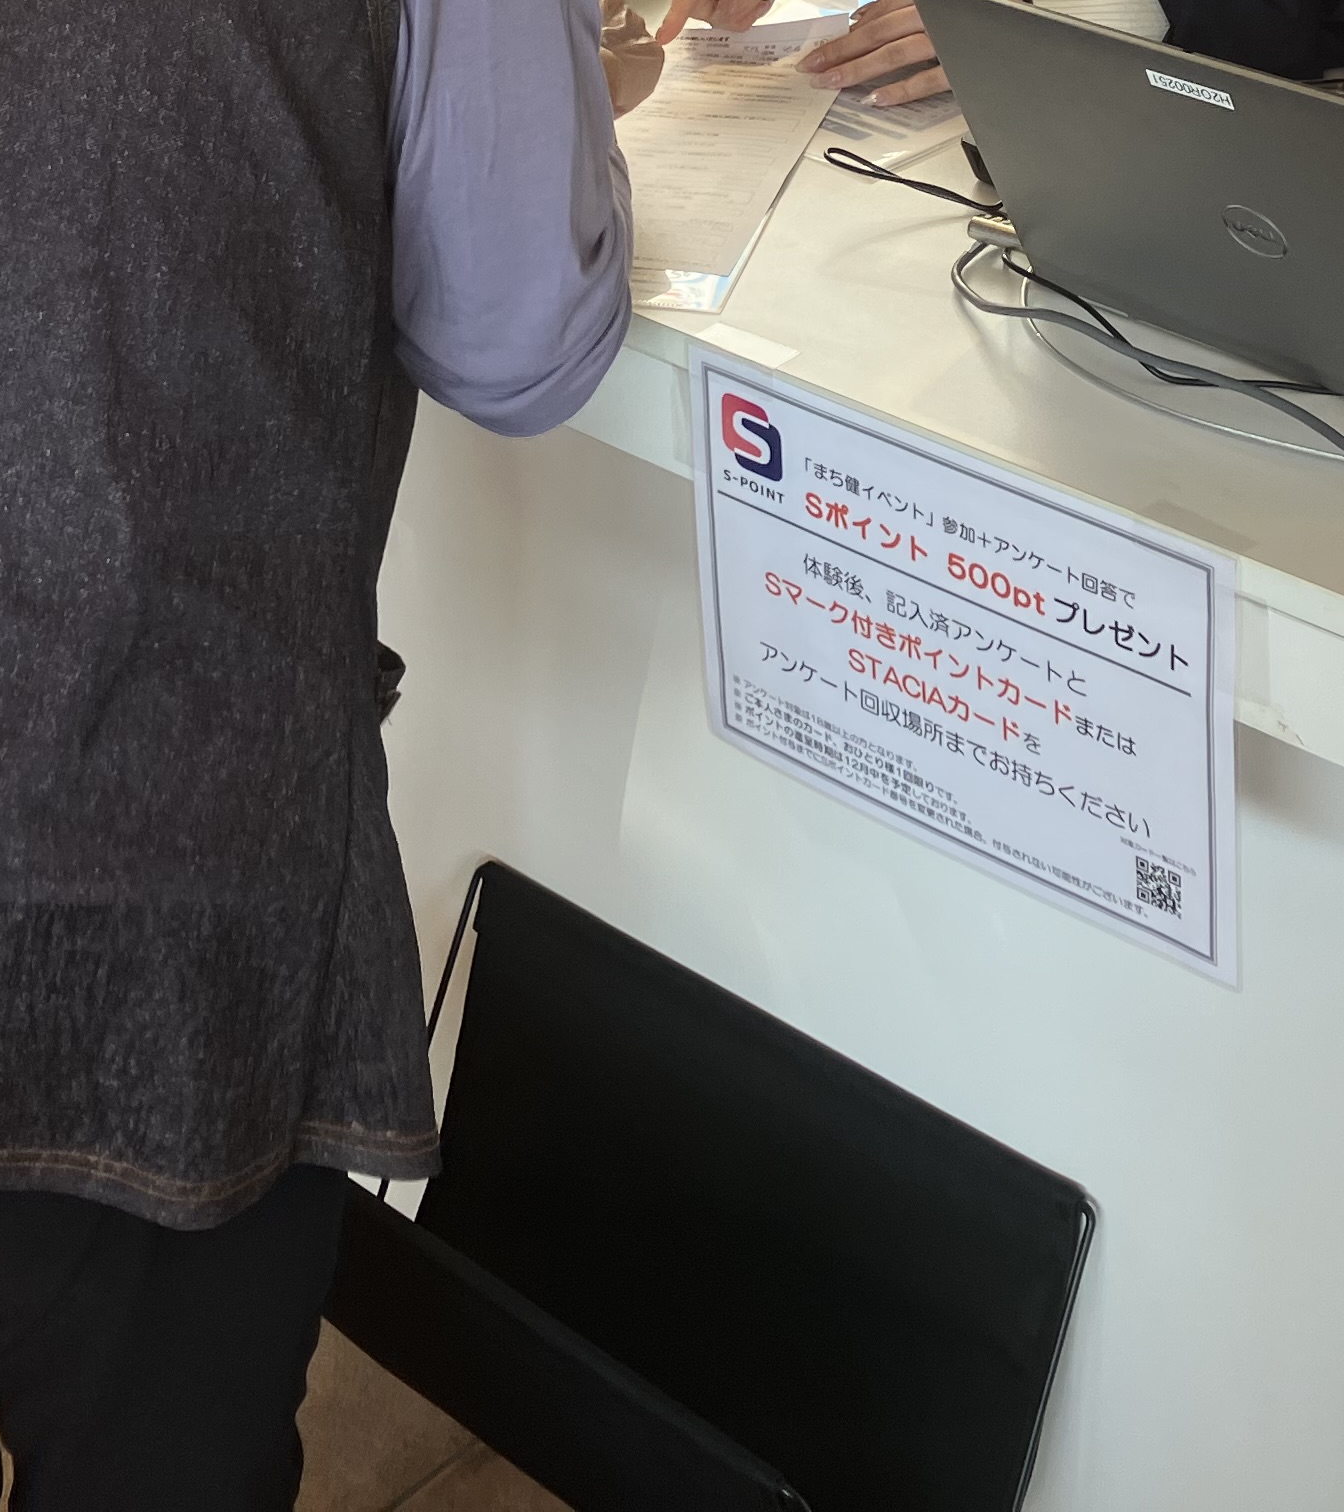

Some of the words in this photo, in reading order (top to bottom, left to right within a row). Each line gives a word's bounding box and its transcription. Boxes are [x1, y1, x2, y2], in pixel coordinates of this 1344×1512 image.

[722, 468, 785, 505] S-POINT
[801, 551, 1088, 697] 体験後、記入済アンケートと
[805, 491, 929, 562] Sポイント
[945, 551, 1047, 618] 500pt
[1054, 596, 1190, 672] プレゼント
[758, 641, 1152, 838] アンケート回収場所までお持ちください
[762, 571, 1138, 757] Sマーク付きポイントカードまたは
[846, 648, 1042, 755] STACIAカードを
